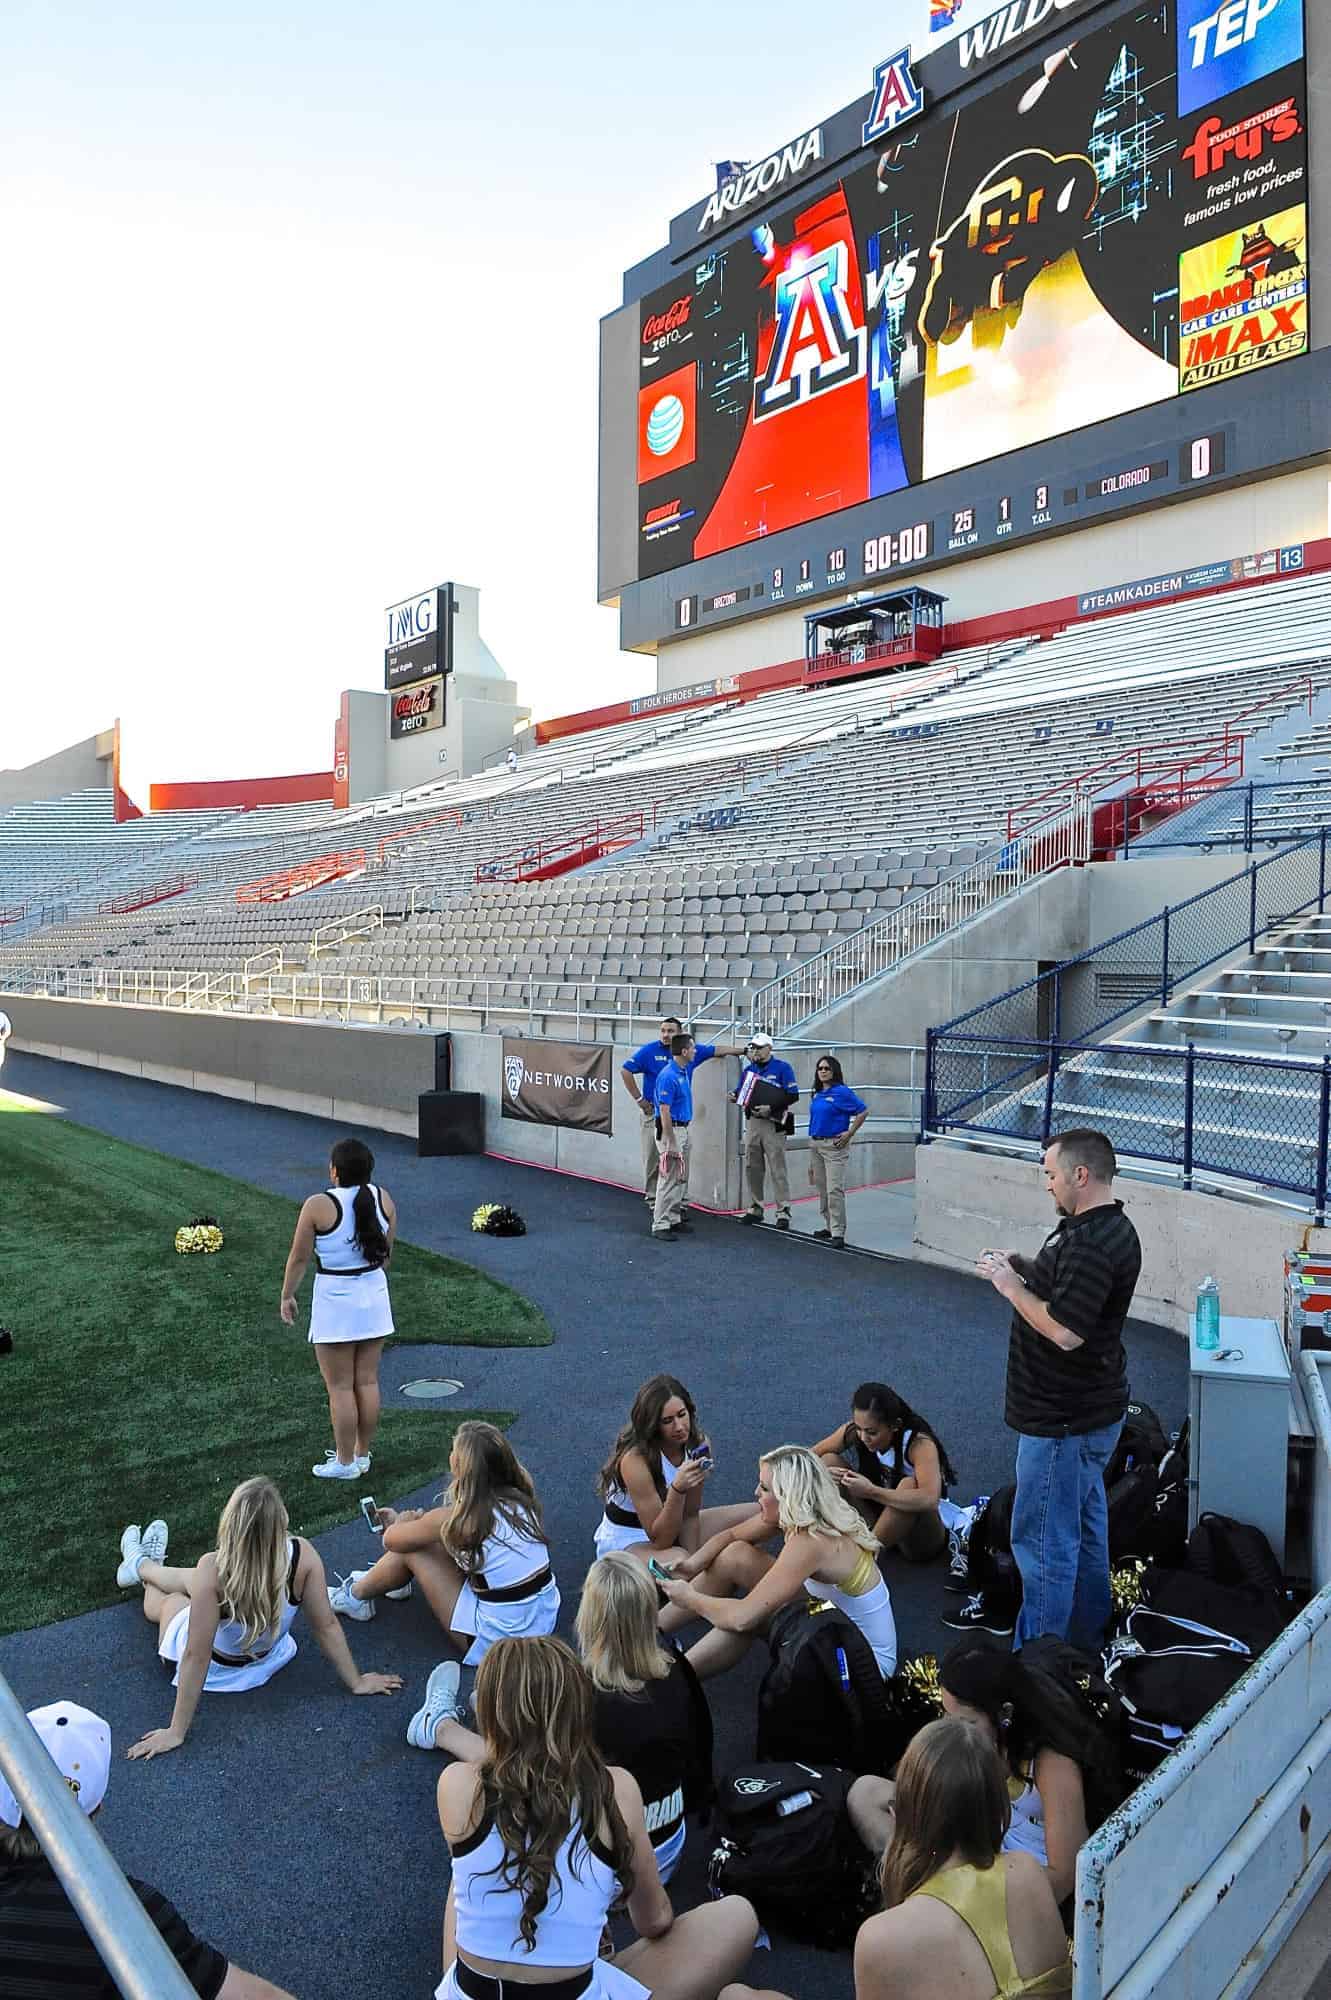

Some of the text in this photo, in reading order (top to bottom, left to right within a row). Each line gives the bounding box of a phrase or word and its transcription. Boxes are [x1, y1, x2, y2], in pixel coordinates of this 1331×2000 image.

[959, 0, 1080, 68] WILD
[1188, 0, 1281, 69] TEP
[862, 44, 924, 147] A
[1208, 101, 1292, 146] FOOD STORES
[697, 128, 822, 232] ARIZONA
[1183, 166, 1304, 227] famous low prices
[1206, 158, 1278, 199] fresh food,
[865, 248, 920, 312] VS
[1181, 279, 1252, 321] BRAKE
[1182, 281, 1305, 335] CAR CARE CENTERS
[753, 240, 868, 426] A
[1183, 333, 1306, 386] AUTO GLASS
[1191, 438, 1210, 480] 0
[1036, 486, 1047, 509] 3
[1101, 466, 1150, 495] COLORADO
[954, 509, 974, 534] 25
[1000, 498, 1009, 520] 1
[829, 549, 844, 571] 10
[864, 523, 928, 575] 90:00
[949, 532, 978, 550] BALL ON
[1281, 550, 1302, 569] 13
[800, 561, 808, 580] 1
[827, 571, 846, 585] TO GO
[680, 598, 690, 627] 0
[1082, 576, 1183, 611] #TEAMKADEEM
[388, 598, 432, 645] IMG
[643, 696, 661, 709] FOLK
[663, 688, 692, 705] HEROES
[401, 715, 423, 731] zero
[524, 1070, 609, 1094] NETWORKS
